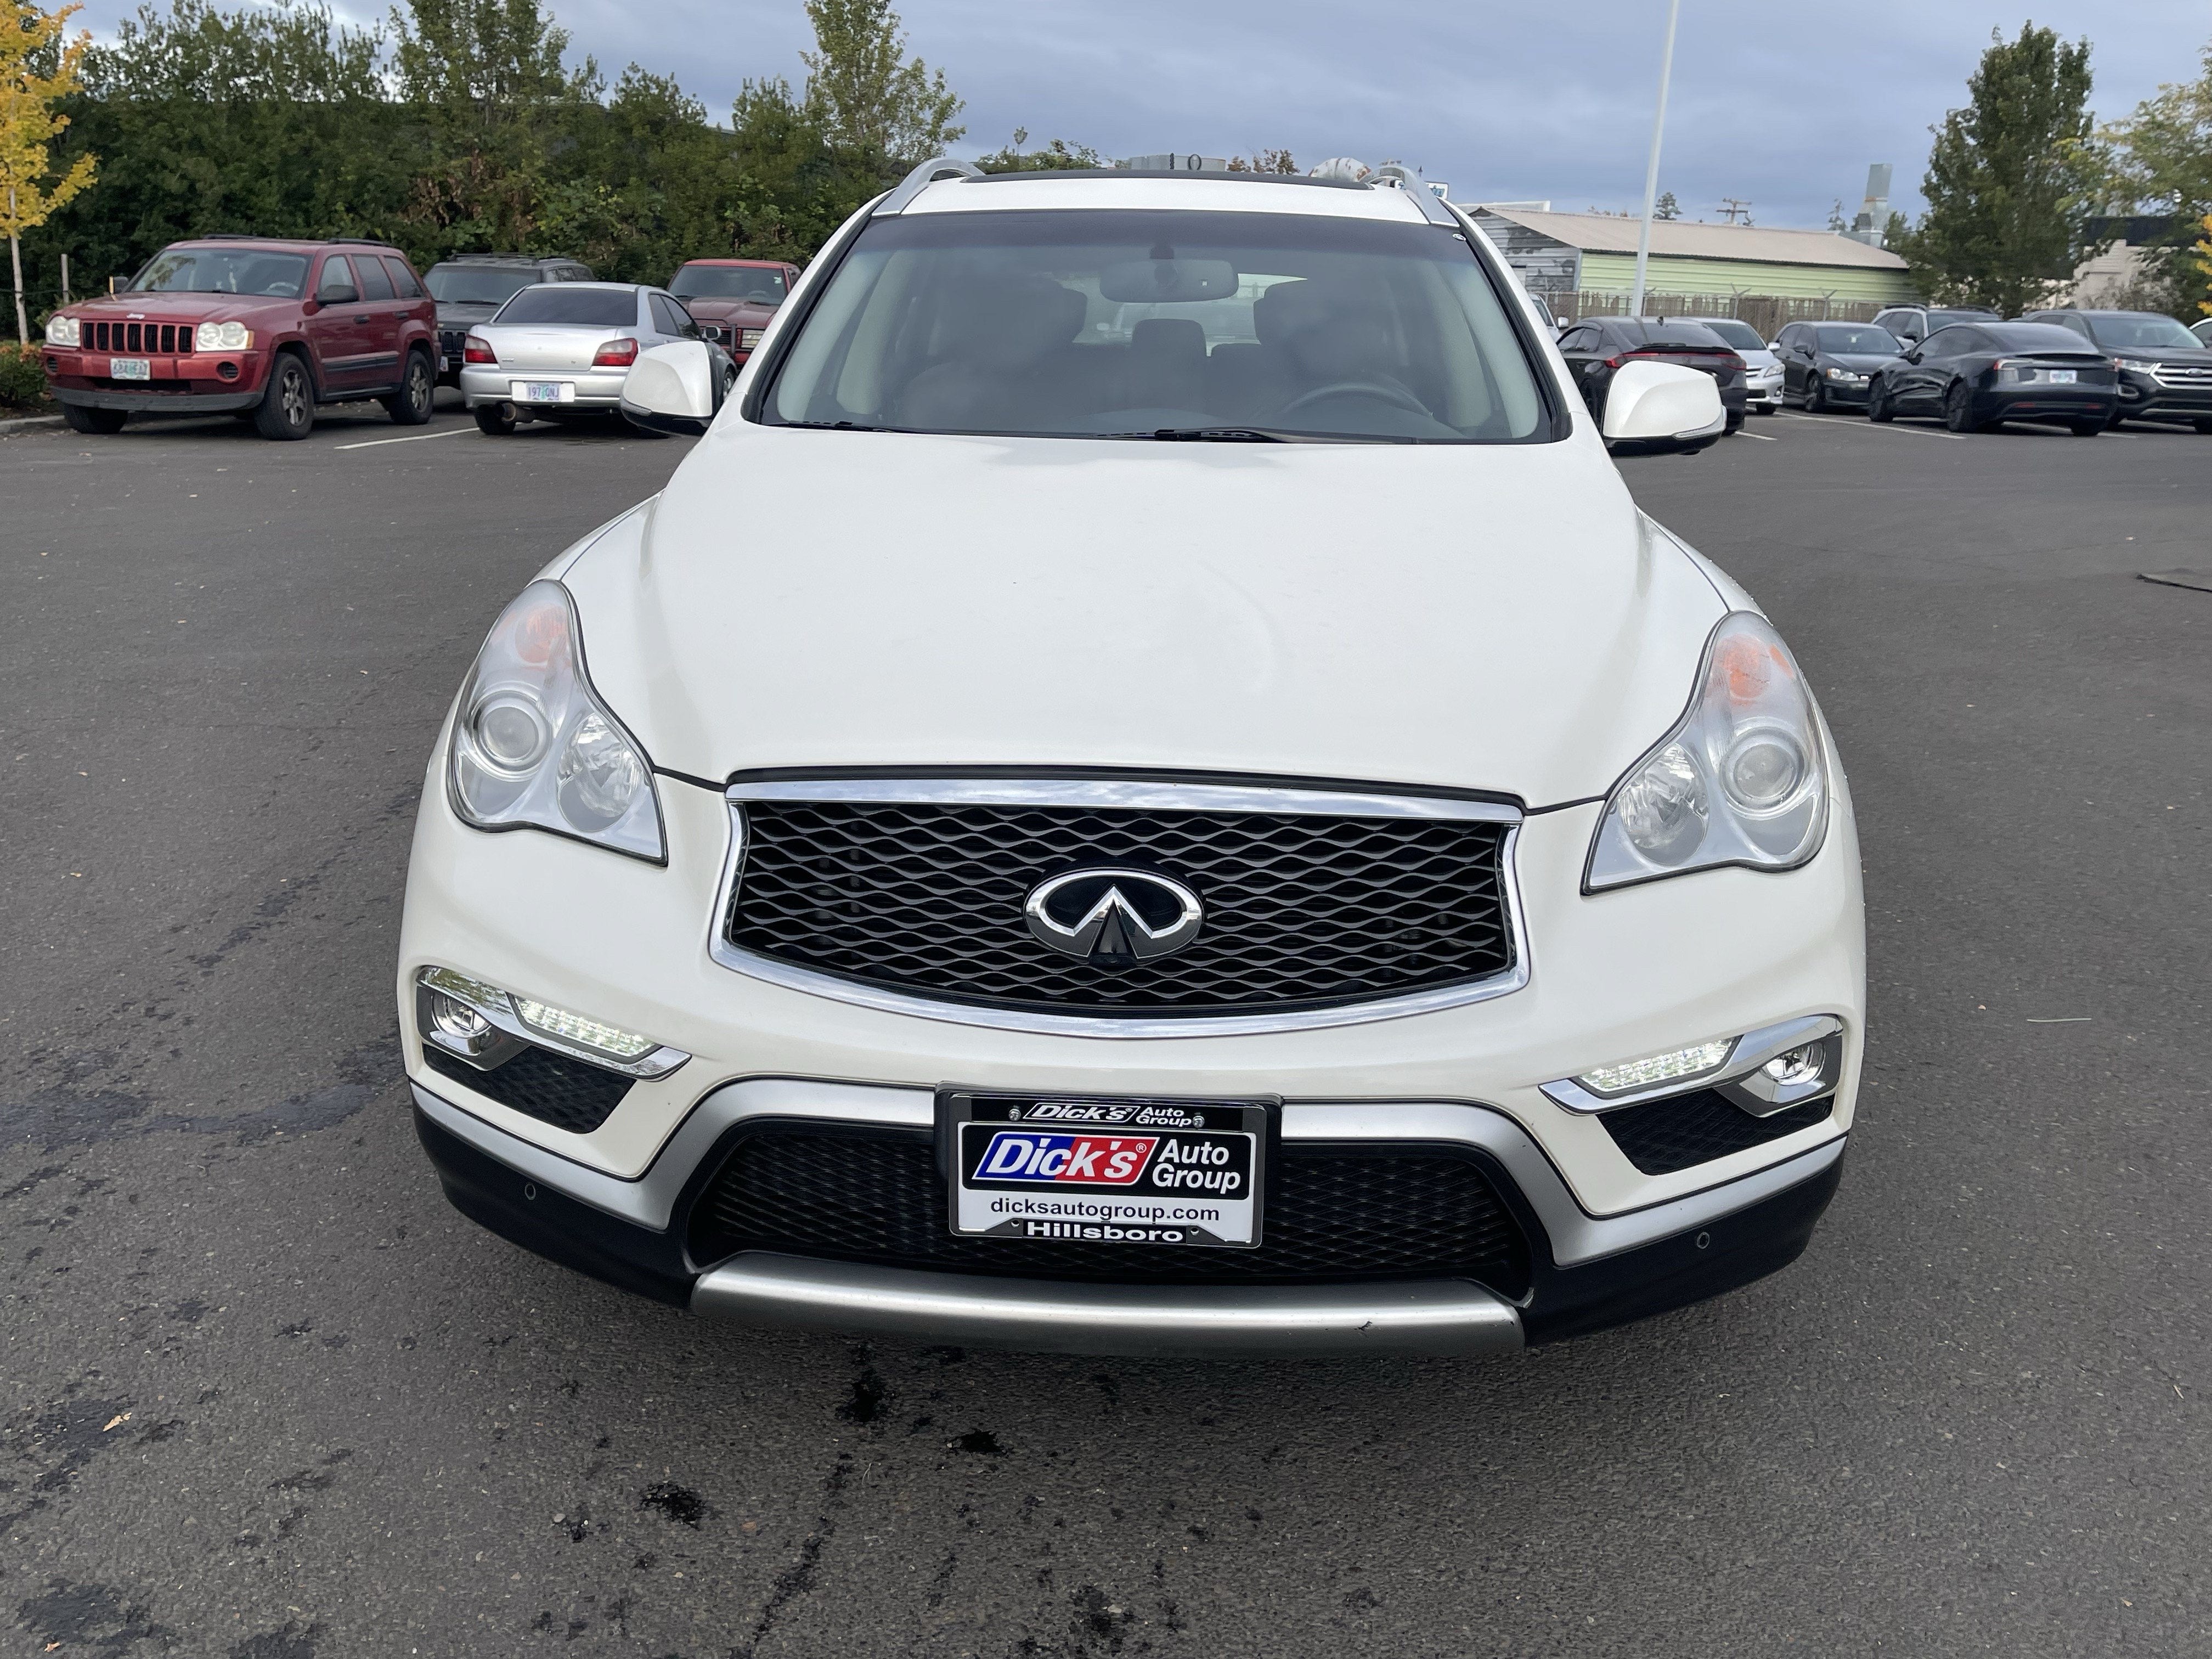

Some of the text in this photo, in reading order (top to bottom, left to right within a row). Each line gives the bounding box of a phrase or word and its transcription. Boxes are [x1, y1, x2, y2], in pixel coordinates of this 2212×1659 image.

[1031, 1105, 1127, 1120] Dick's
[1136, 1115, 1192, 1127] Group
[1139, 1107, 1184, 1117] Auto
[986, 1138, 1137, 1178] Dick's
[1158, 1139, 1229, 1165] Auto
[1153, 1163, 1240, 1194] Group
[991, 1198, 1219, 1223] dicksautogroup.com
[1028, 1221, 1183, 1242] Hillsboro
